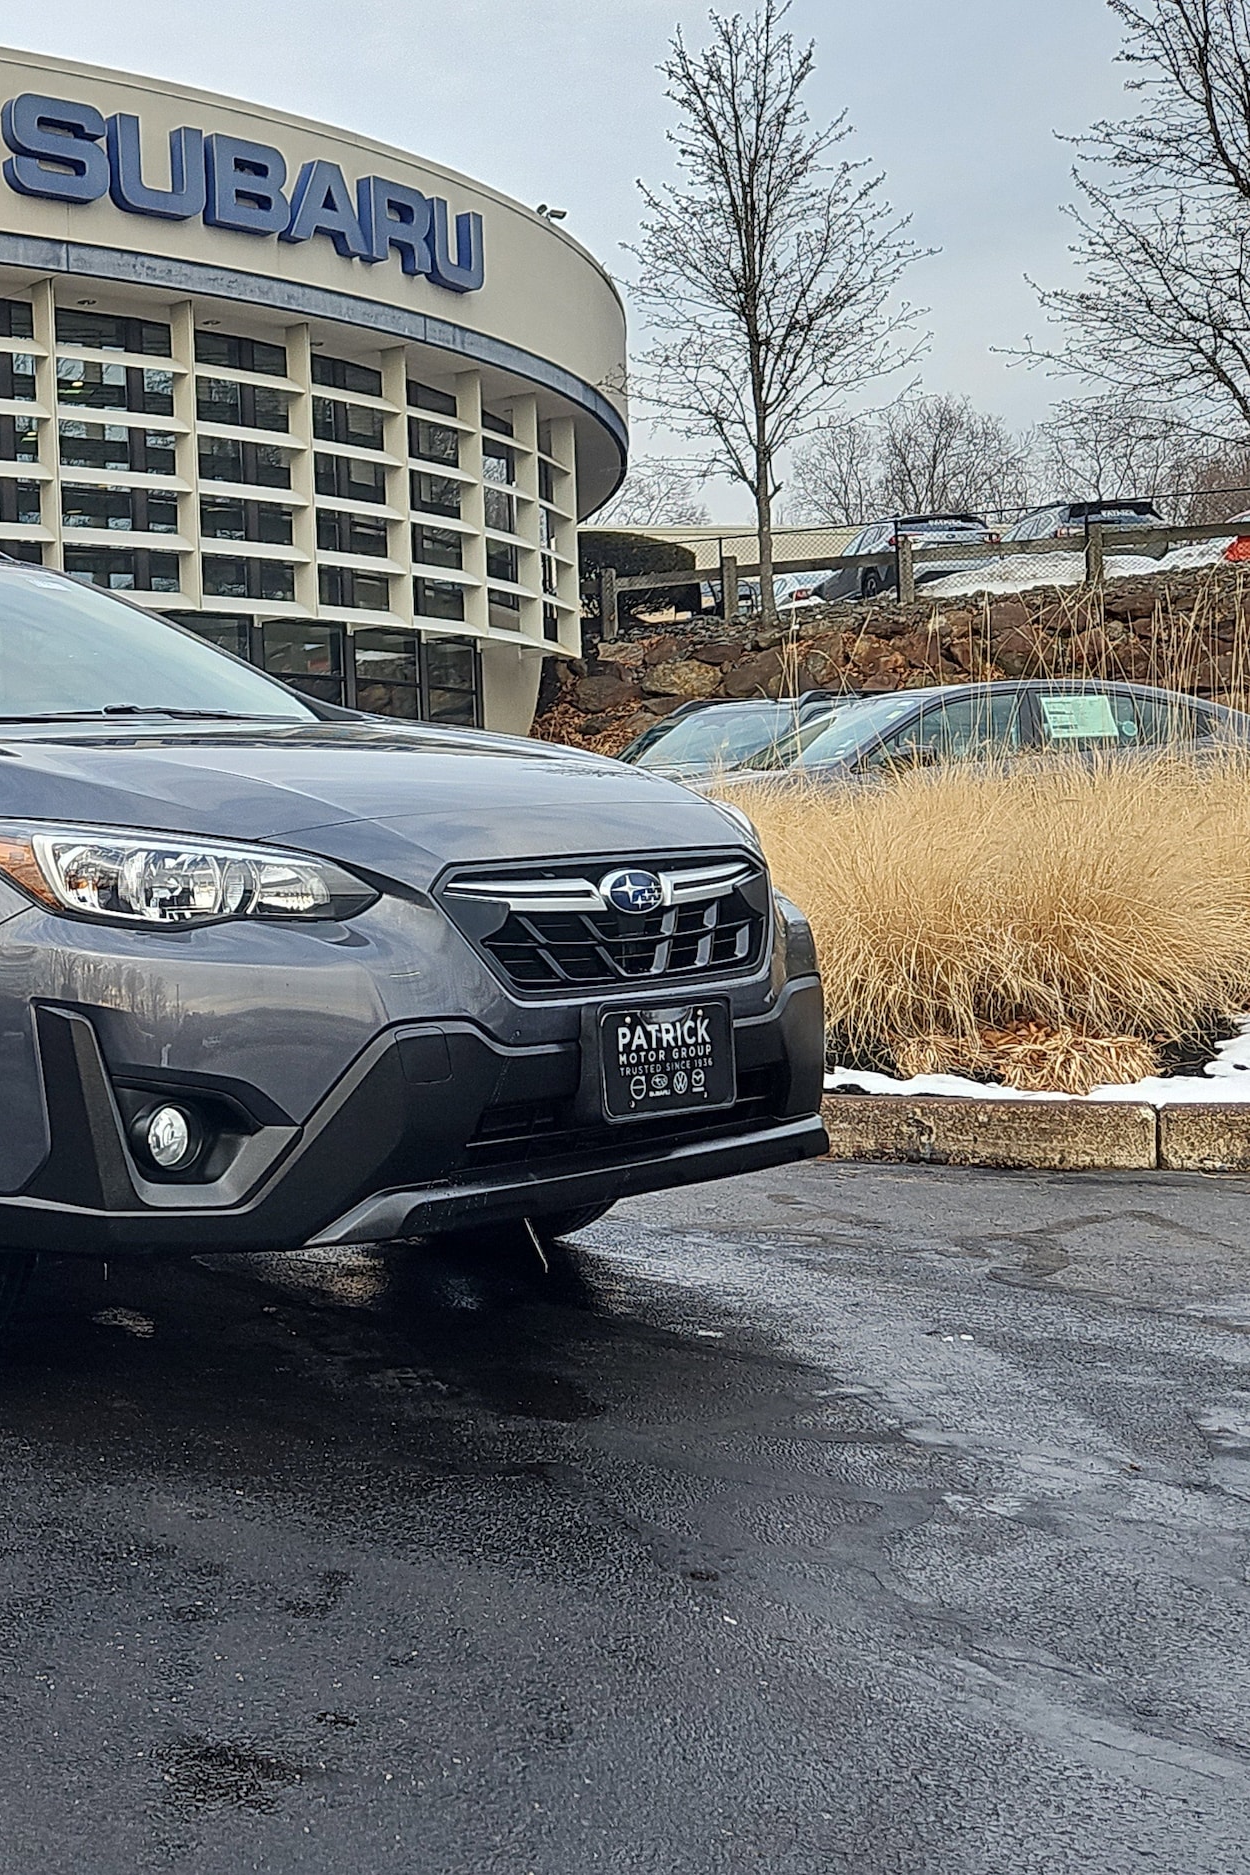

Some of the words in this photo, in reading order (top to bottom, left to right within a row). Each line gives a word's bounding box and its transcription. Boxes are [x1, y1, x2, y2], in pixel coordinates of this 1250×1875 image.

[0, 92, 485, 293] SUBARU
[617, 1017, 711, 1052] PATRICK
[618, 1050, 665, 1065] MOTOR
[672, 1044, 712, 1059] GROUP
[619, 1064, 662, 1076] TRUSTED
[666, 1060, 691, 1071] SINCE
[694, 1057, 713, 1067] 1936
